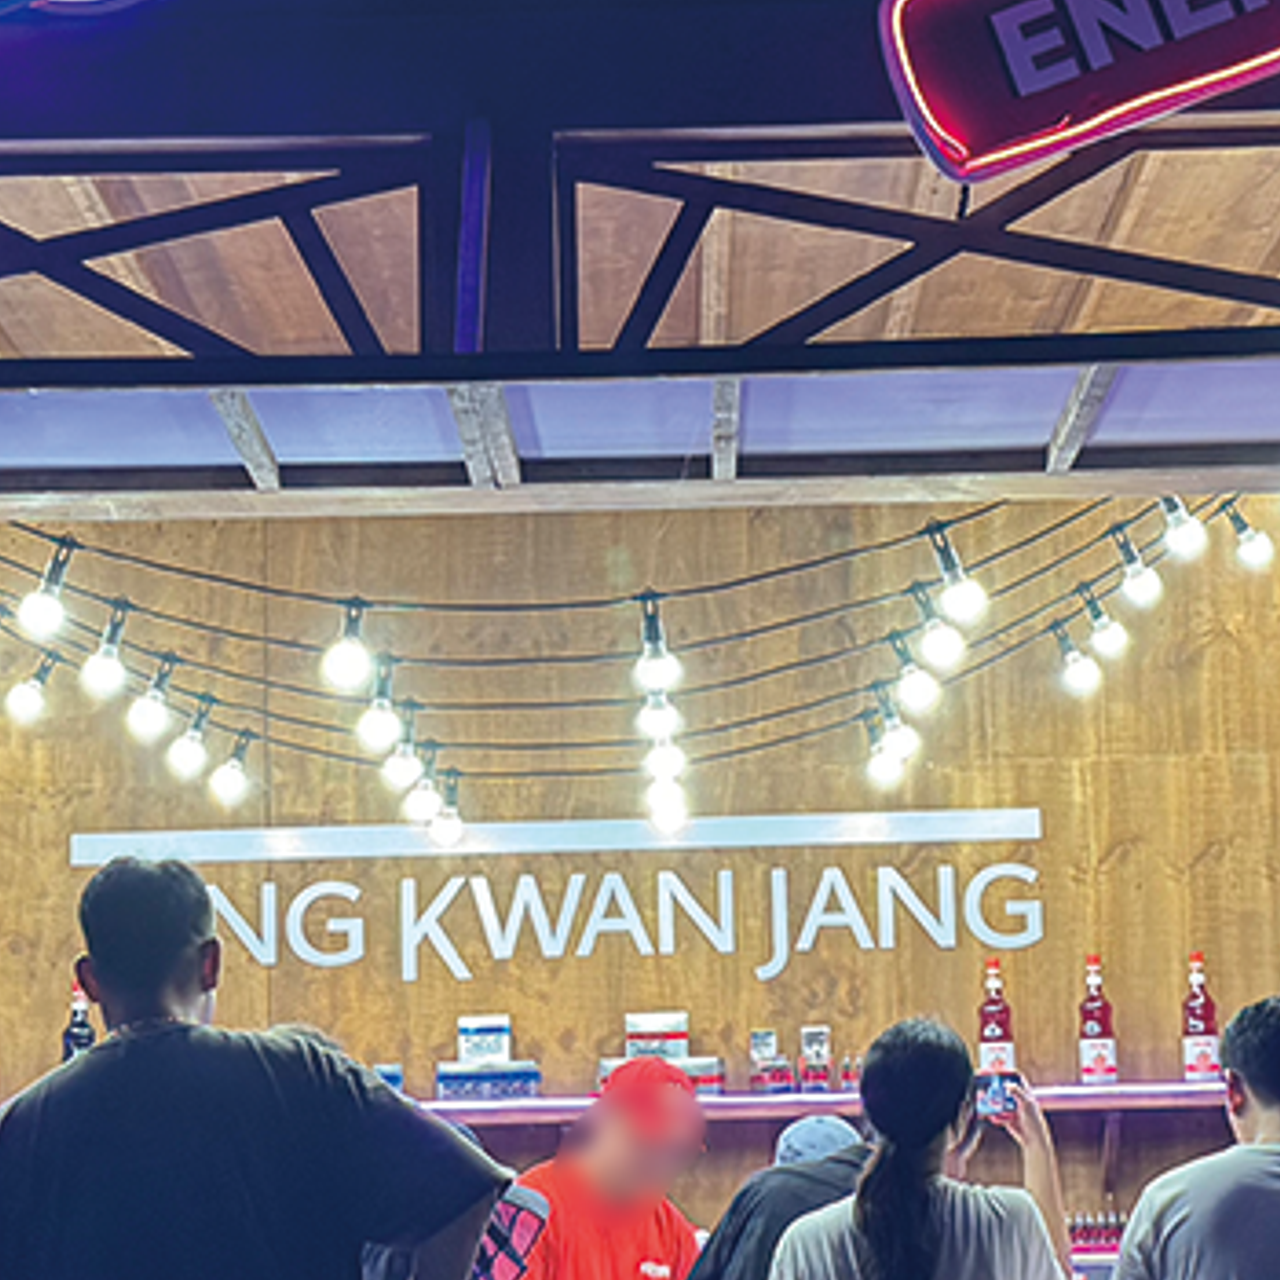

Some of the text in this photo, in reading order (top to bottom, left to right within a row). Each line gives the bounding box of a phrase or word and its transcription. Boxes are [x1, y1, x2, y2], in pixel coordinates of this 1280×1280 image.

[207, 861, 1045, 982] NG KWAN JANG
